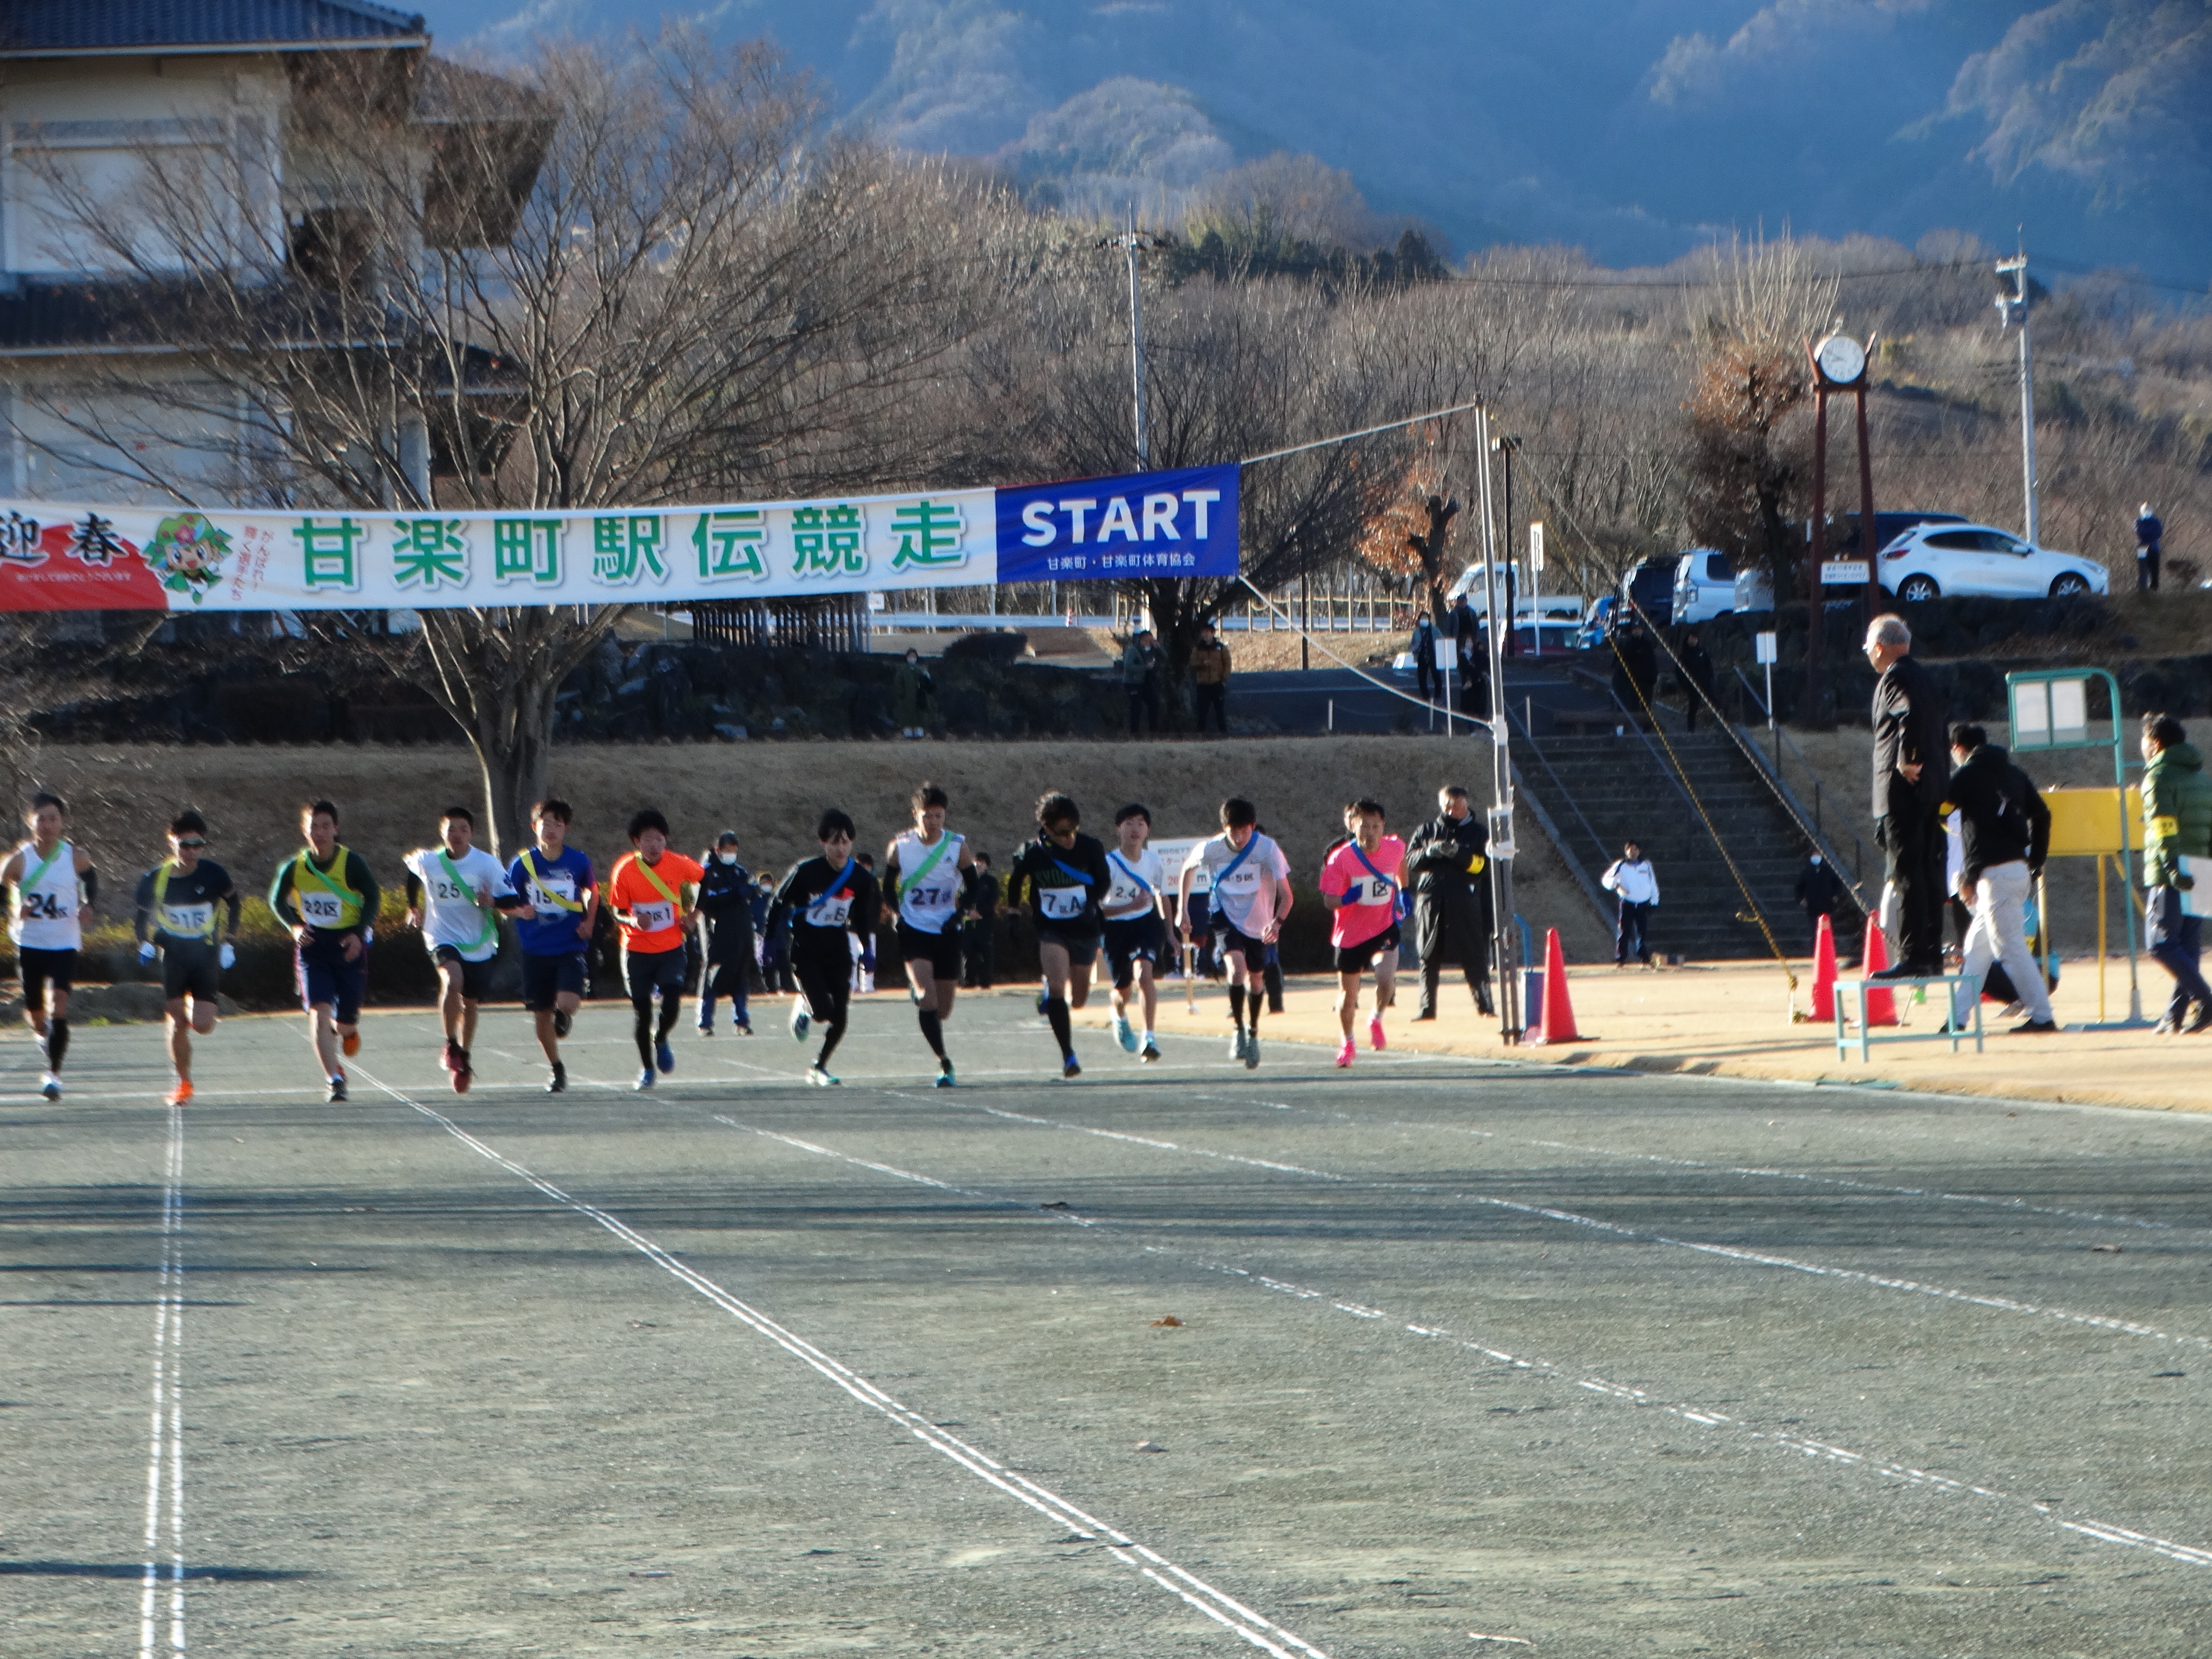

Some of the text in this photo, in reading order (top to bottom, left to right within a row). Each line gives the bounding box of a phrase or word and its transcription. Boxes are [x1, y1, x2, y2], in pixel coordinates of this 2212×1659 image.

[293, 501, 962, 586] 甘楽町駅伝競走
[1021, 489, 1220, 547] START
